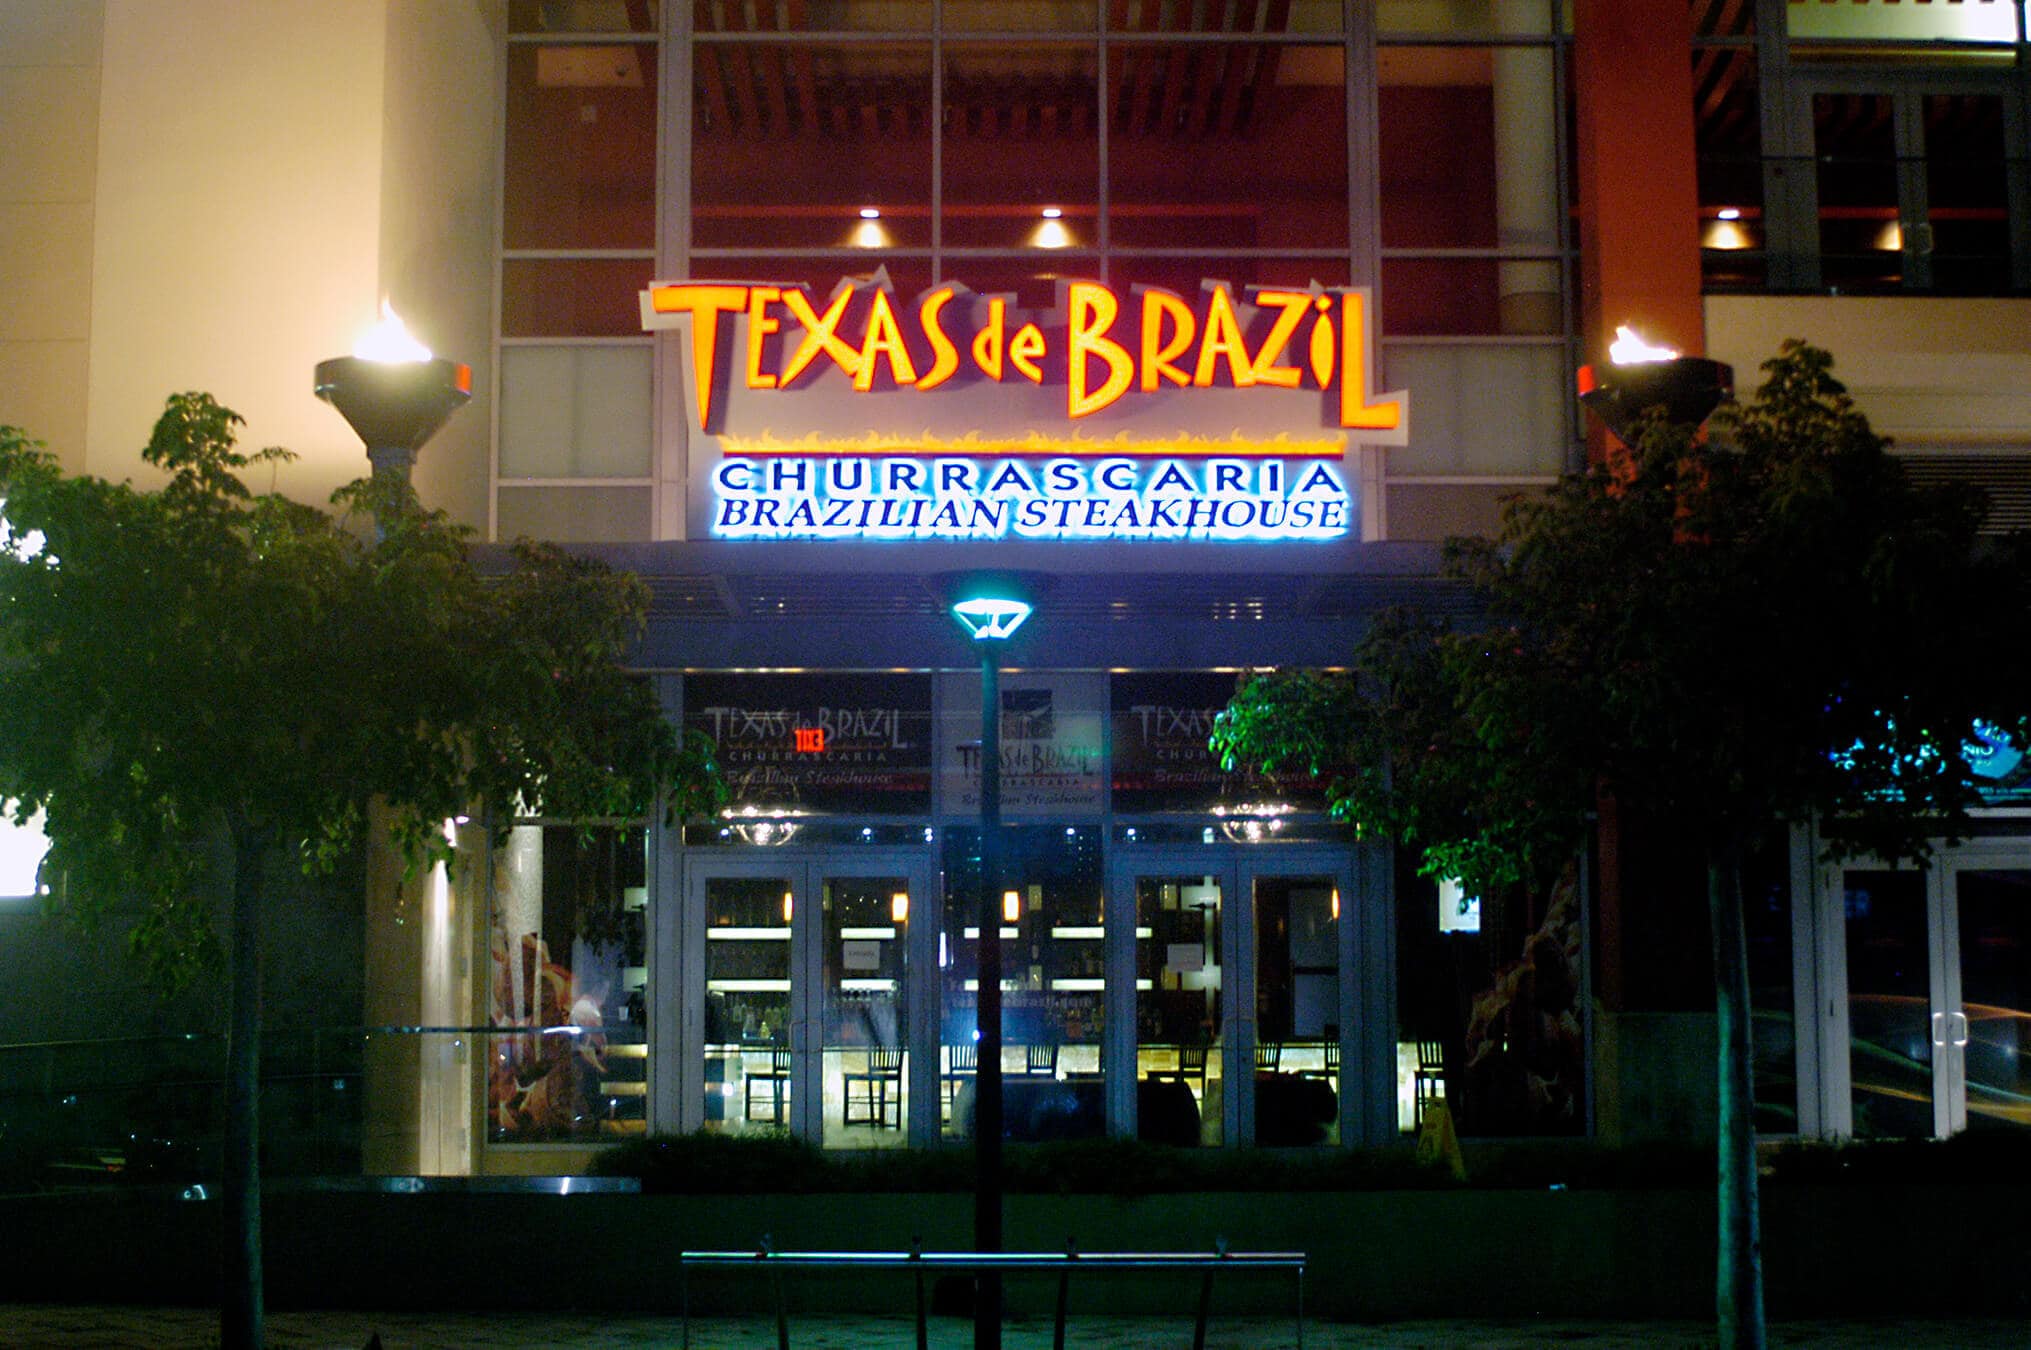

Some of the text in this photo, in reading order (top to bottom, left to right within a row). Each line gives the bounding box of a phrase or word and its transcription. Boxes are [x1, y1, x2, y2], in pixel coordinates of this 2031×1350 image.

[651, 282, 960, 431] TEXAS
[972, 296, 1045, 383] de
[719, 461, 1343, 491] CHURRASCARIA
[718, 498, 1346, 528] BRAZILIAN STEAKHOUSE
[703, 706, 786, 750] TEXAS
